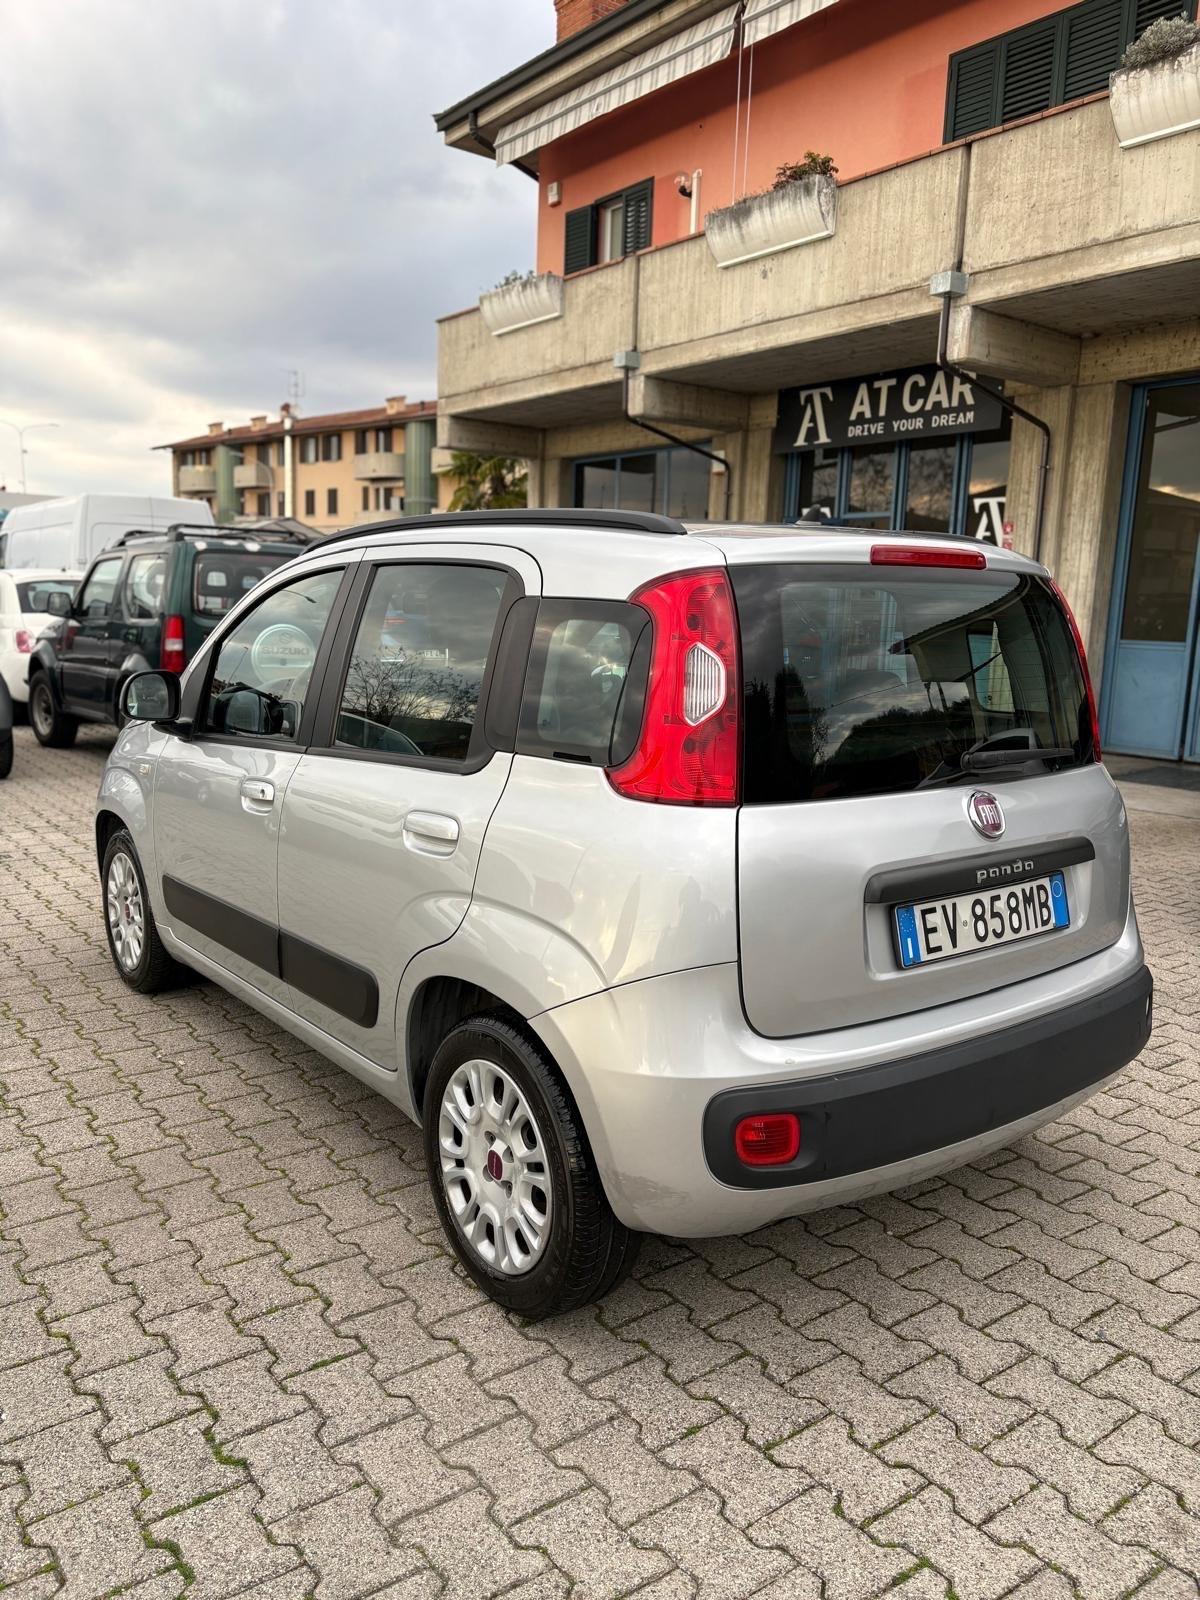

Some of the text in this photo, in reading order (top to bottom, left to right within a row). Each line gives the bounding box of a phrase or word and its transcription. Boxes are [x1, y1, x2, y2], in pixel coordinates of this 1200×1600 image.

[849, 369, 977, 421] AT CAR
[847, 411, 975, 438] DRIVE YOUR DREAM
[978, 804, 1000, 825] FIAT
[977, 859, 1034, 884] panda
